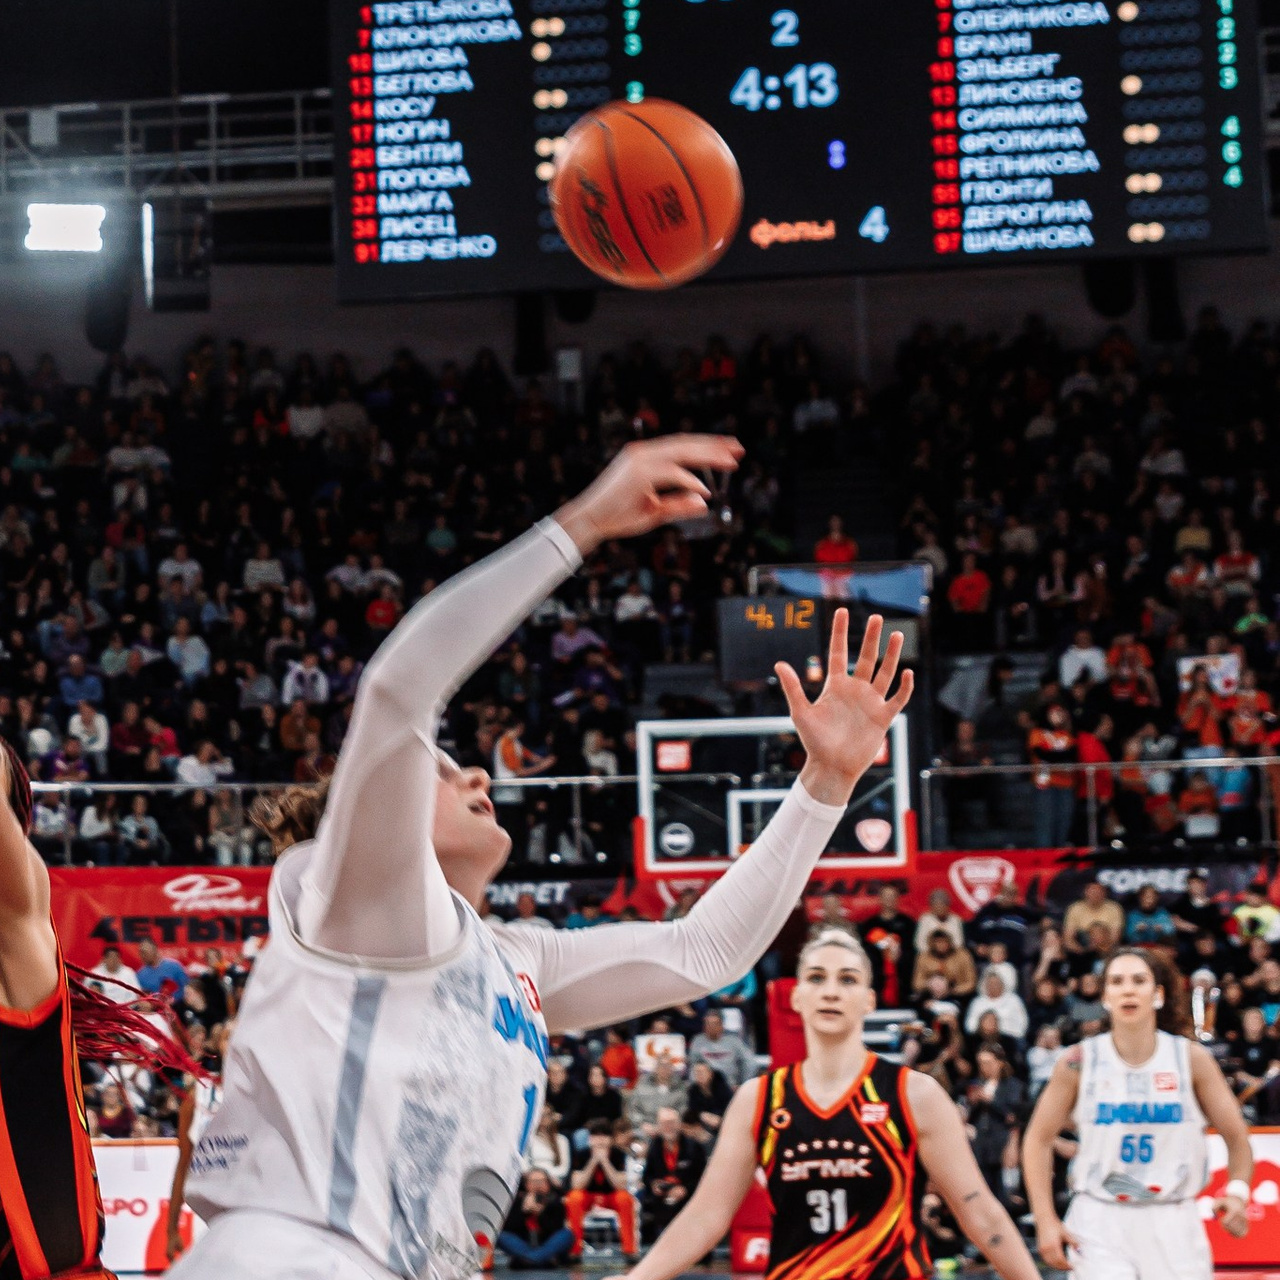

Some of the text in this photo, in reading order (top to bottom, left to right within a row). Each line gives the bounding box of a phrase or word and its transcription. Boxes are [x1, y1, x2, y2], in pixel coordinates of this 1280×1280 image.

[770, 9, 801, 47] 2
[729, 62, 839, 111] 4:13
[374, 95, 436, 120] КОСУ
[377, 165, 472, 191] ПОПОВА
[749, 204, 890, 250] фолы 4
[380, 235, 498, 263] ЛЕВЧЕНКО
[1120, 1133, 1155, 1164] 55
[781, 1157, 873, 1182] УГМК
[806, 1188, 849, 1234] 31
